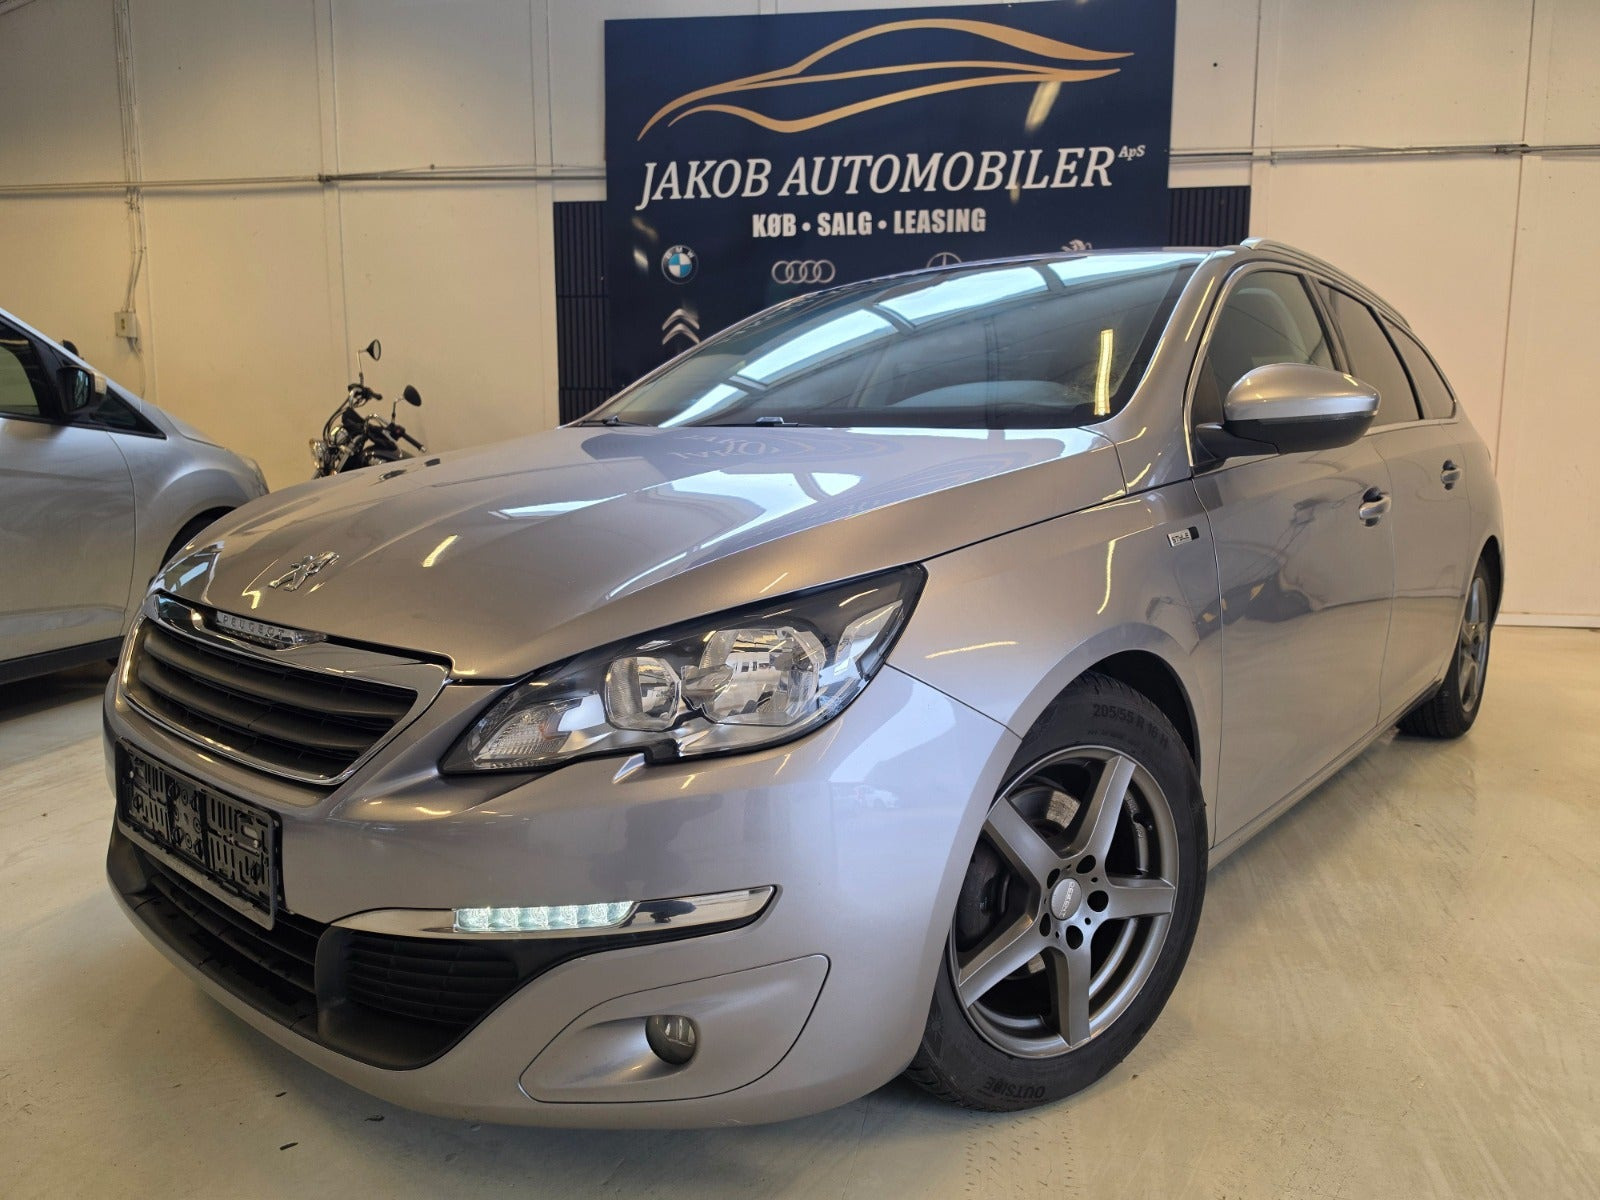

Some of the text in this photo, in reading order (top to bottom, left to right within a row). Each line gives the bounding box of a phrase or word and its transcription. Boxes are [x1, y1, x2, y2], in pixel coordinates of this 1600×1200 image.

[635, 144, 1146, 211] JAKOB AUTOMOBILER ApS
[752, 207, 987, 238] KØB SALG LEASING
[223, 614, 285, 637] PEUGEOT
